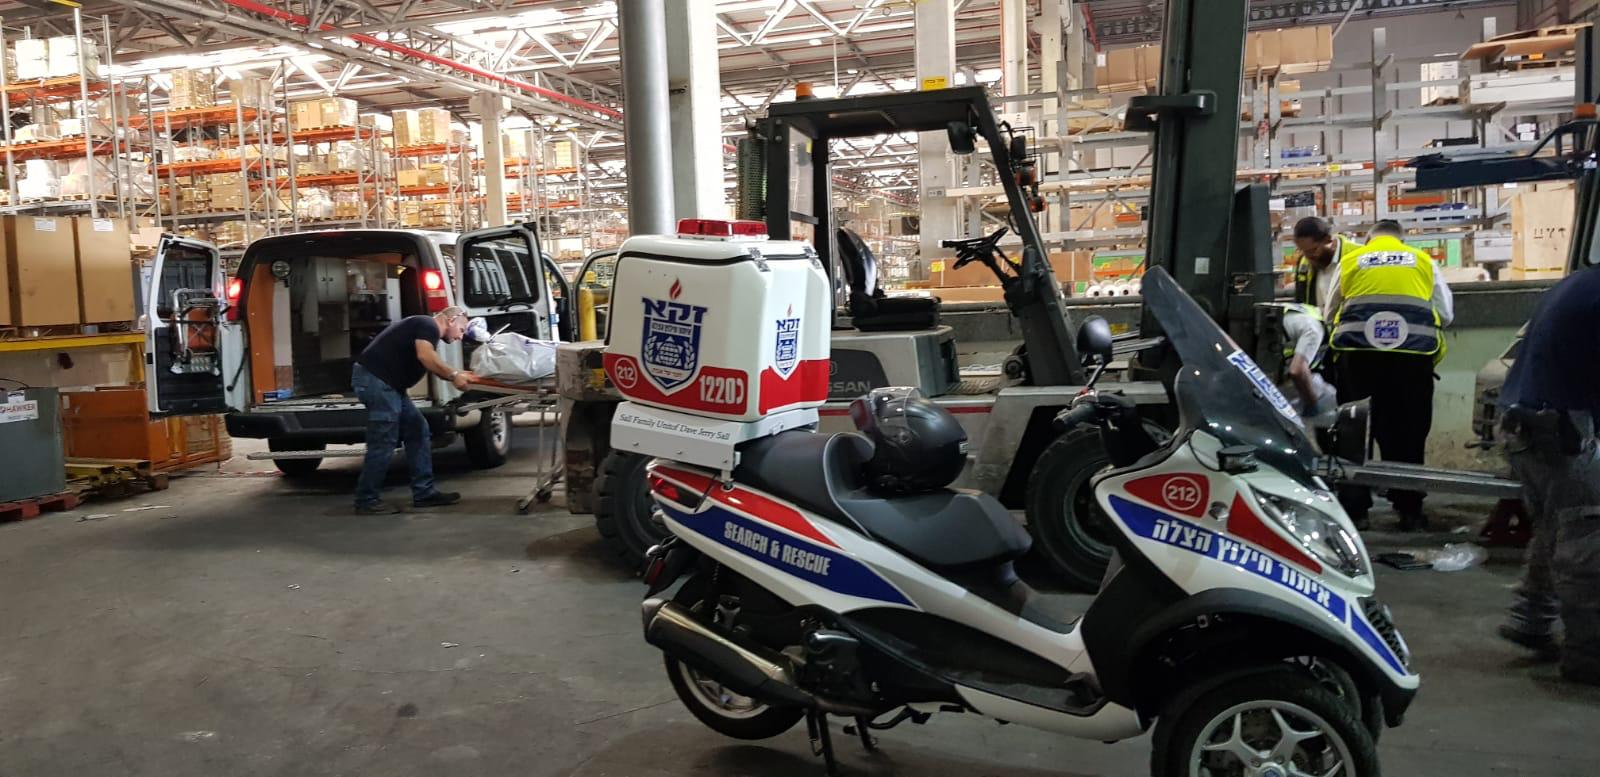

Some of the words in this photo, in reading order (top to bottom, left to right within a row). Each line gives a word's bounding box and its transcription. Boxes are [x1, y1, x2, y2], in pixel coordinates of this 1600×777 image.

[641, 296, 708, 324] זקא
[776, 318, 800, 331] זקא
[617, 366, 635, 381] 212
[632, 416, 655, 428] Family
[1167, 485, 1196, 502] 212
[724, 521, 768, 554] SEARCH
[770, 540, 780, 559] &
[782, 543, 832, 576] RESCUE
[1152, 519, 1213, 552] הצלה
[1216, 532, 1274, 575] חילוץ
[1279, 562, 1331, 608] איתור
